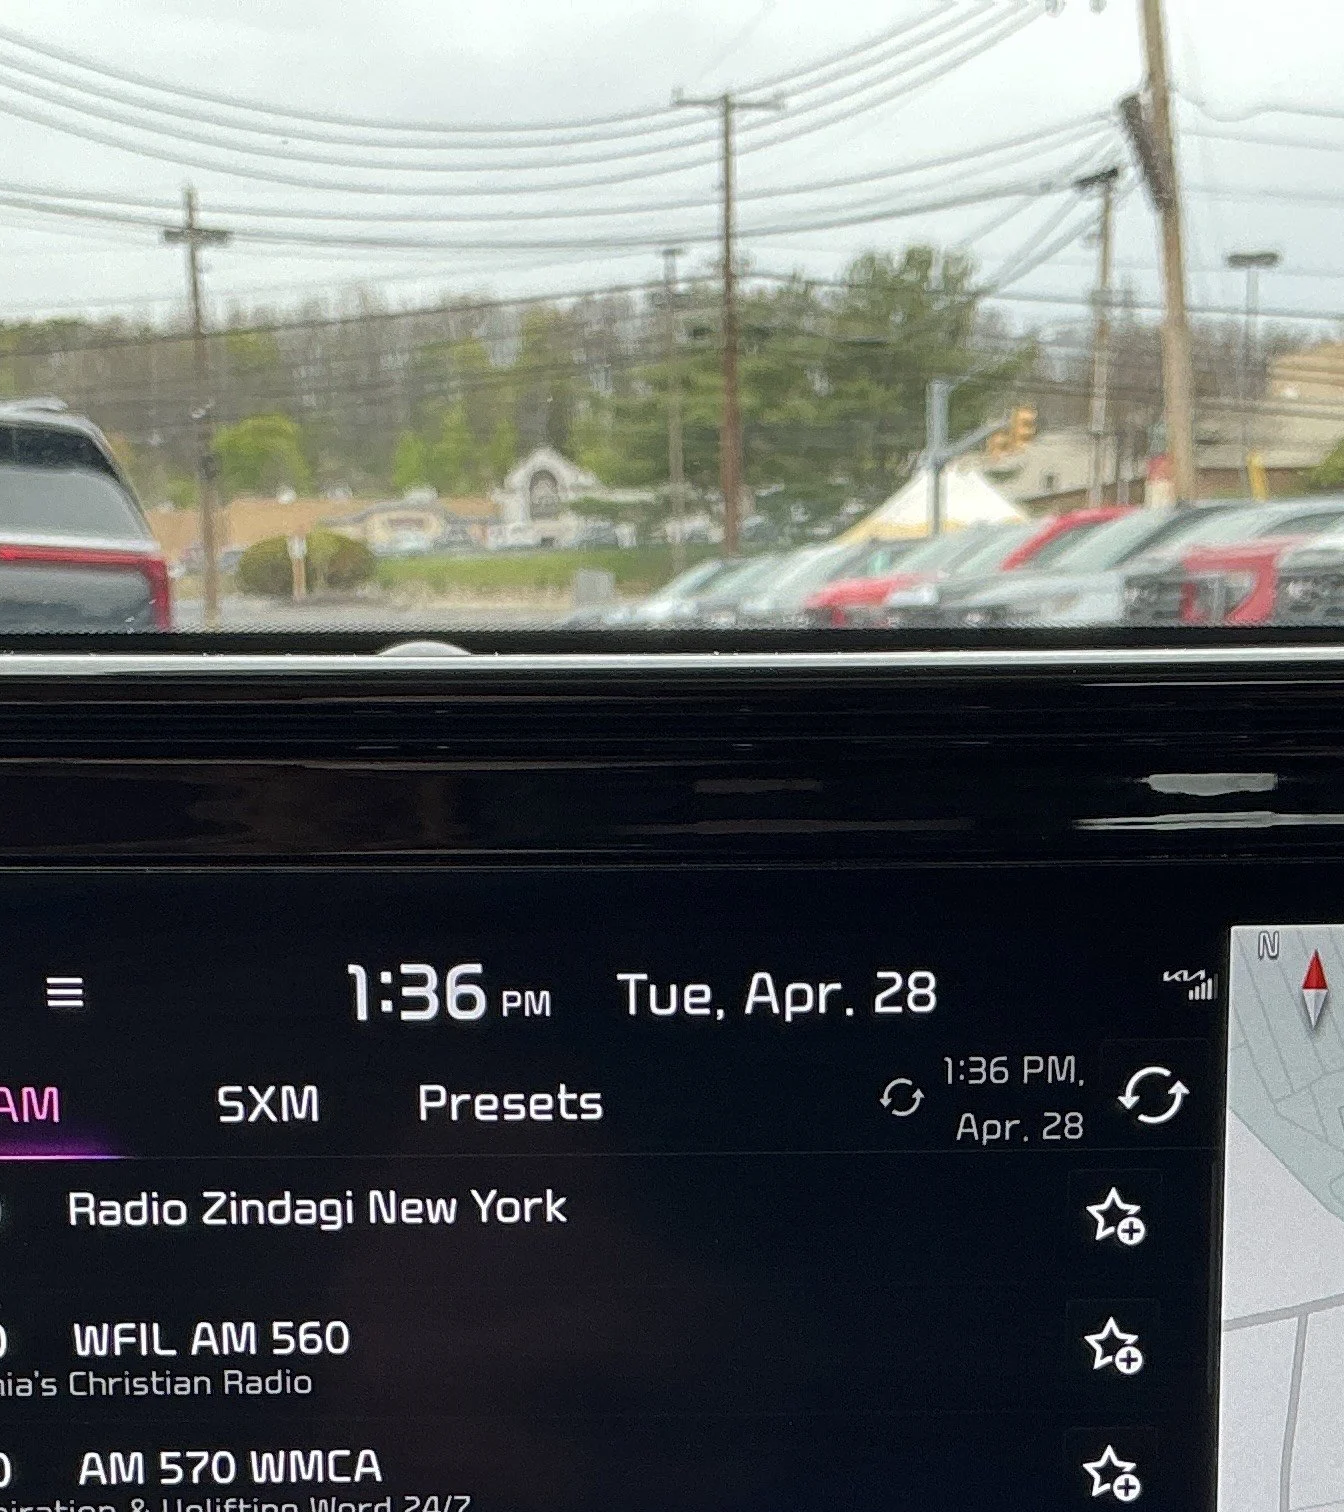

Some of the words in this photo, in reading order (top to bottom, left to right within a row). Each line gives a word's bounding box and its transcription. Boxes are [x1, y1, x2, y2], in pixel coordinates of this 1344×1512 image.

[1258, 930, 1280, 960] N
[348, 964, 486, 1021] 1:36
[503, 991, 550, 1017] PM
[617, 974, 724, 1020] Tue,
[745, 972, 853, 1022] Apr.
[875, 971, 936, 1013] 28
[944, 1056, 1009, 1084] 1:36
[218, 1085, 318, 1122] SXM
[420, 1084, 602, 1121] Presets
[956, 1113, 1028, 1145] Apr.
[1043, 1112, 1083, 1139] 28
[69, 1192, 187, 1226] Radio
[202, 1190, 353, 1230] Zindagi
[370, 1190, 457, 1224] New
[471, 1189, 567, 1223] York
[74, 1323, 177, 1356] WFIL
[191, 1322, 256, 1355] AM
[273, 1321, 349, 1354] 560
[69, 1371, 211, 1395] Christian
[224, 1369, 312, 1394] Radio
[79, 1452, 144, 1485] AM
[160, 1451, 236, 1484] 570
[251, 1449, 382, 1483] WMCA
